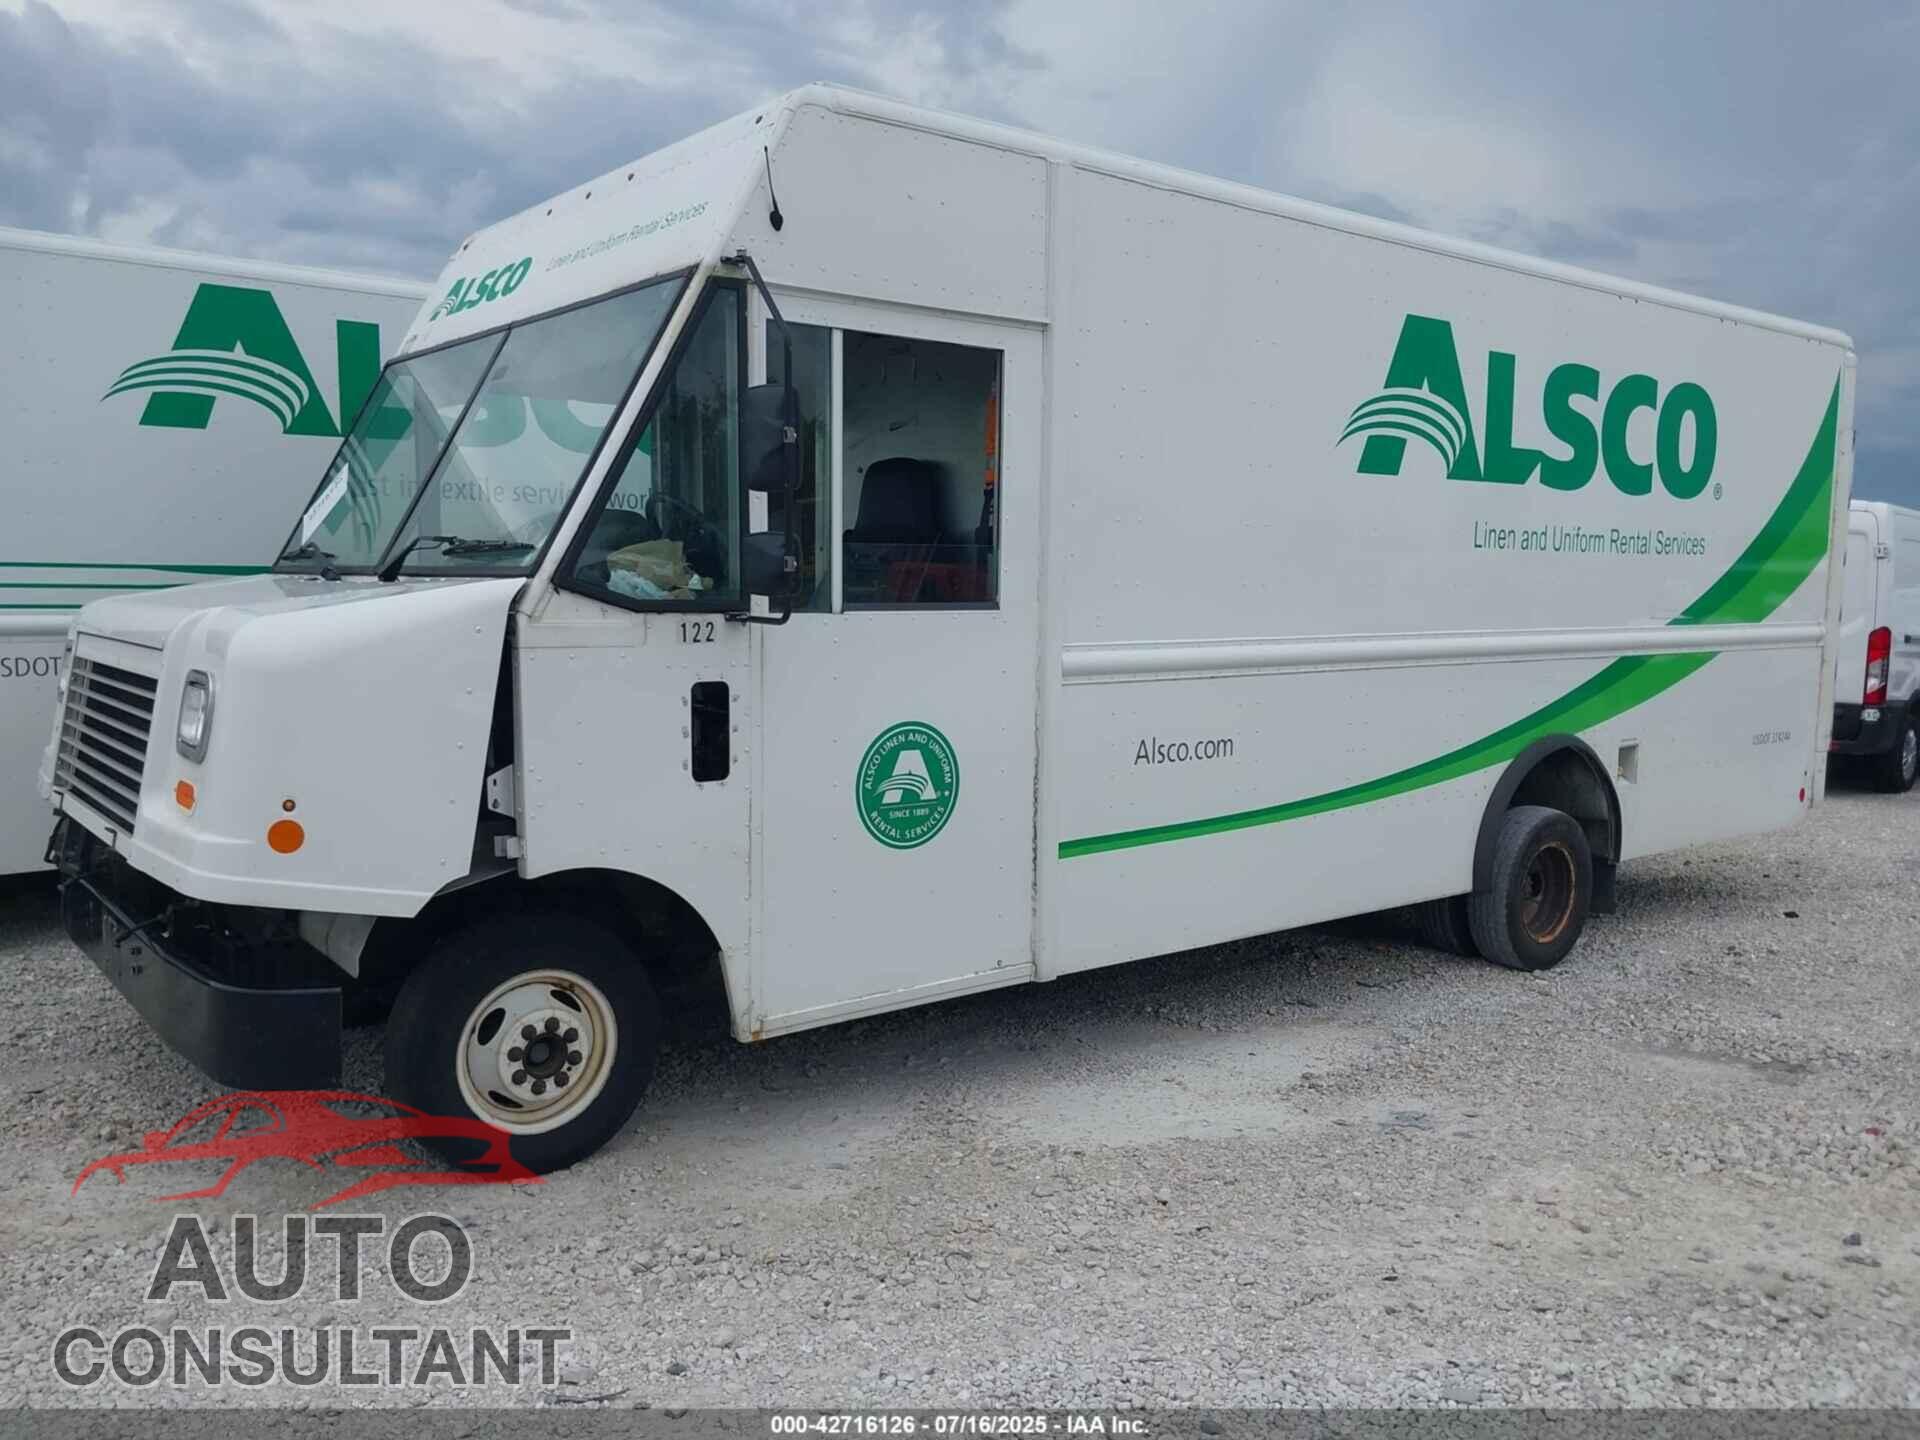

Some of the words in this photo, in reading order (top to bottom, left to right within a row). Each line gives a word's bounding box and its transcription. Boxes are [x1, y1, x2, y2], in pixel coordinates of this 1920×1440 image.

[430, 257, 532, 322] ALSCO
[1336, 314, 1718, 500] ALSCO
[1473, 520, 1516, 549] Linen
[1521, 525, 1548, 551] and
[1553, 525, 1605, 553] Uniform
[1610, 528, 1651, 555] Rental
[1655, 530, 1705, 556] Services
[681, 622, 714, 643] 122
[864, 755, 881, 790] ALSCO
[880, 733, 905, 755] LINEN
[907, 732, 928, 744] AND
[928, 740, 952, 784] UNIFORM
[1134, 736, 1233, 765] Alsco.com
[870, 810, 901, 839] RENTAL
[904, 806, 945, 839] SERVICES
[889, 809, 910, 819] SINCE
